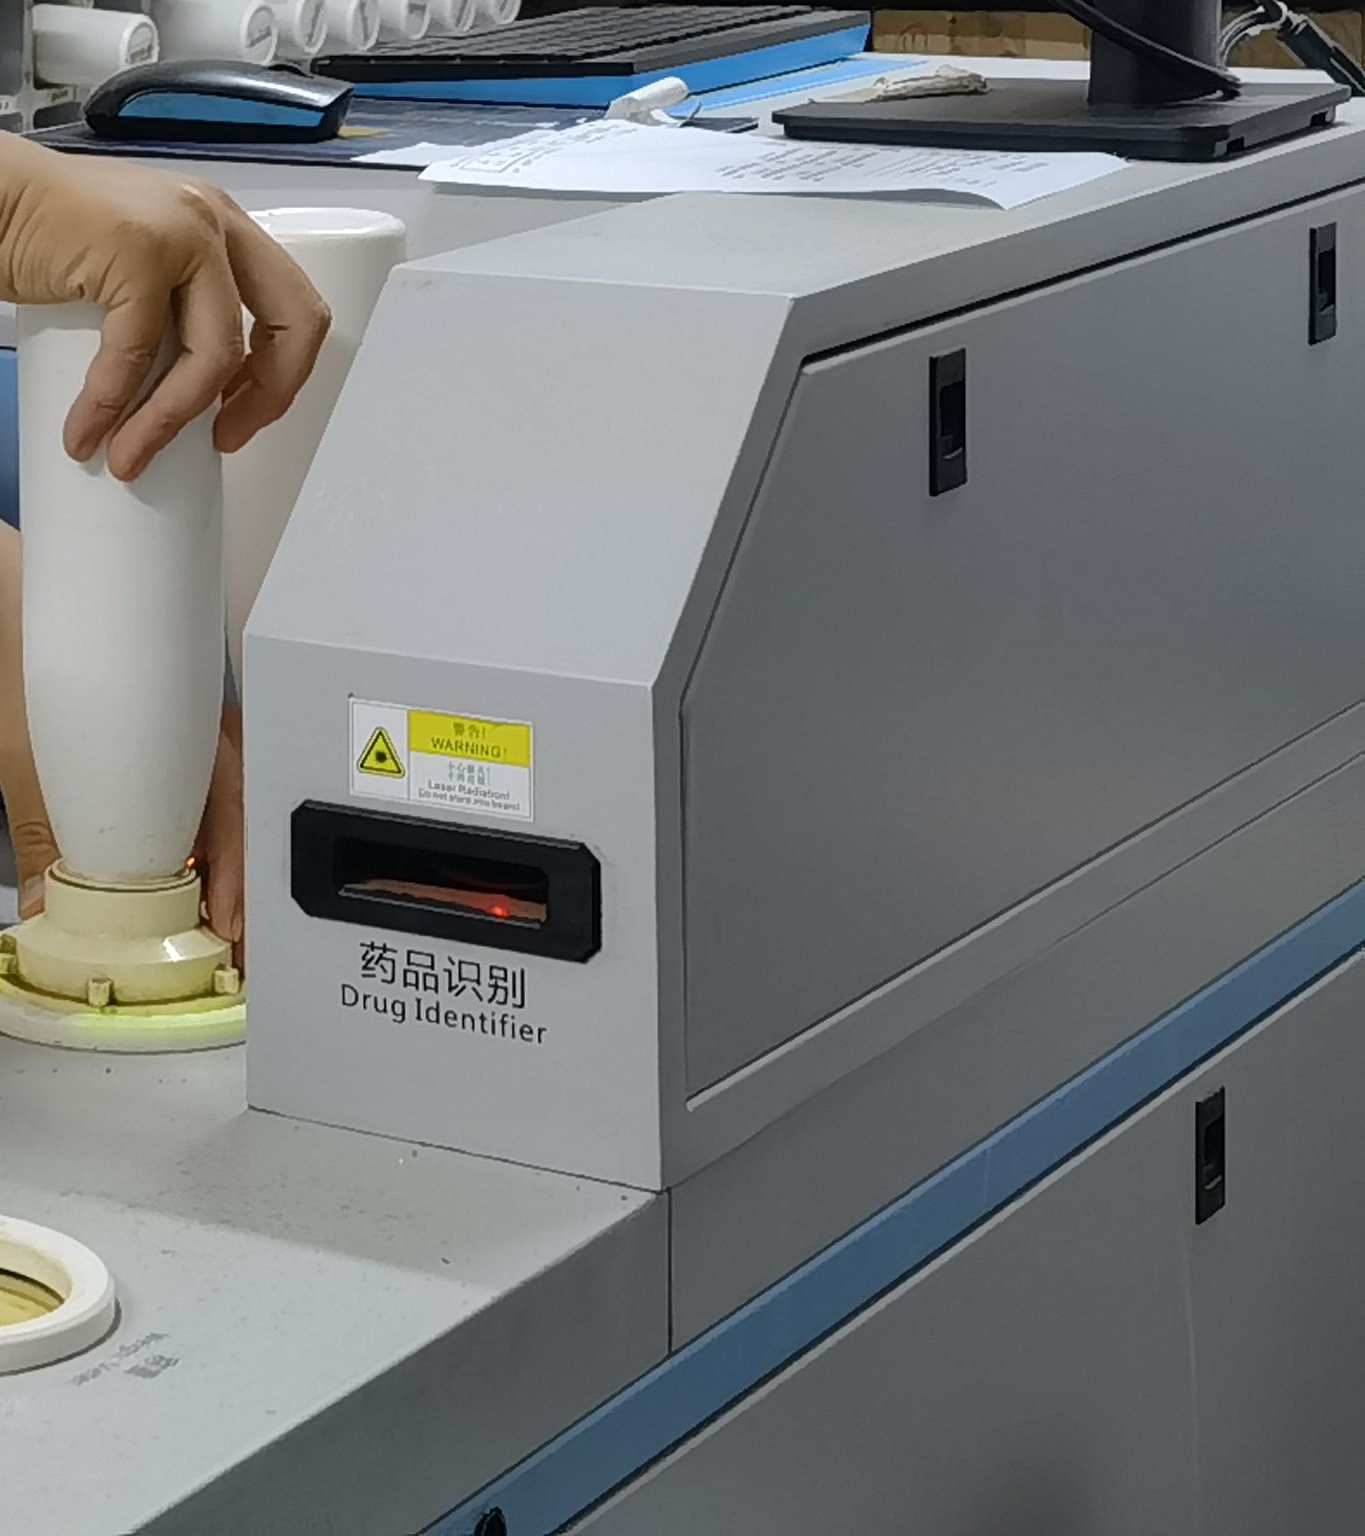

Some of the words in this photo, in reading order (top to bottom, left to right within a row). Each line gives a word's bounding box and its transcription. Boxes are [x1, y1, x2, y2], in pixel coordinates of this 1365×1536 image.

[431, 736, 508, 758] WARNING!
[359, 941, 526, 1009] 药品识别
[340, 983, 407, 1024] Drug
[415, 997, 548, 1045] Identifier
